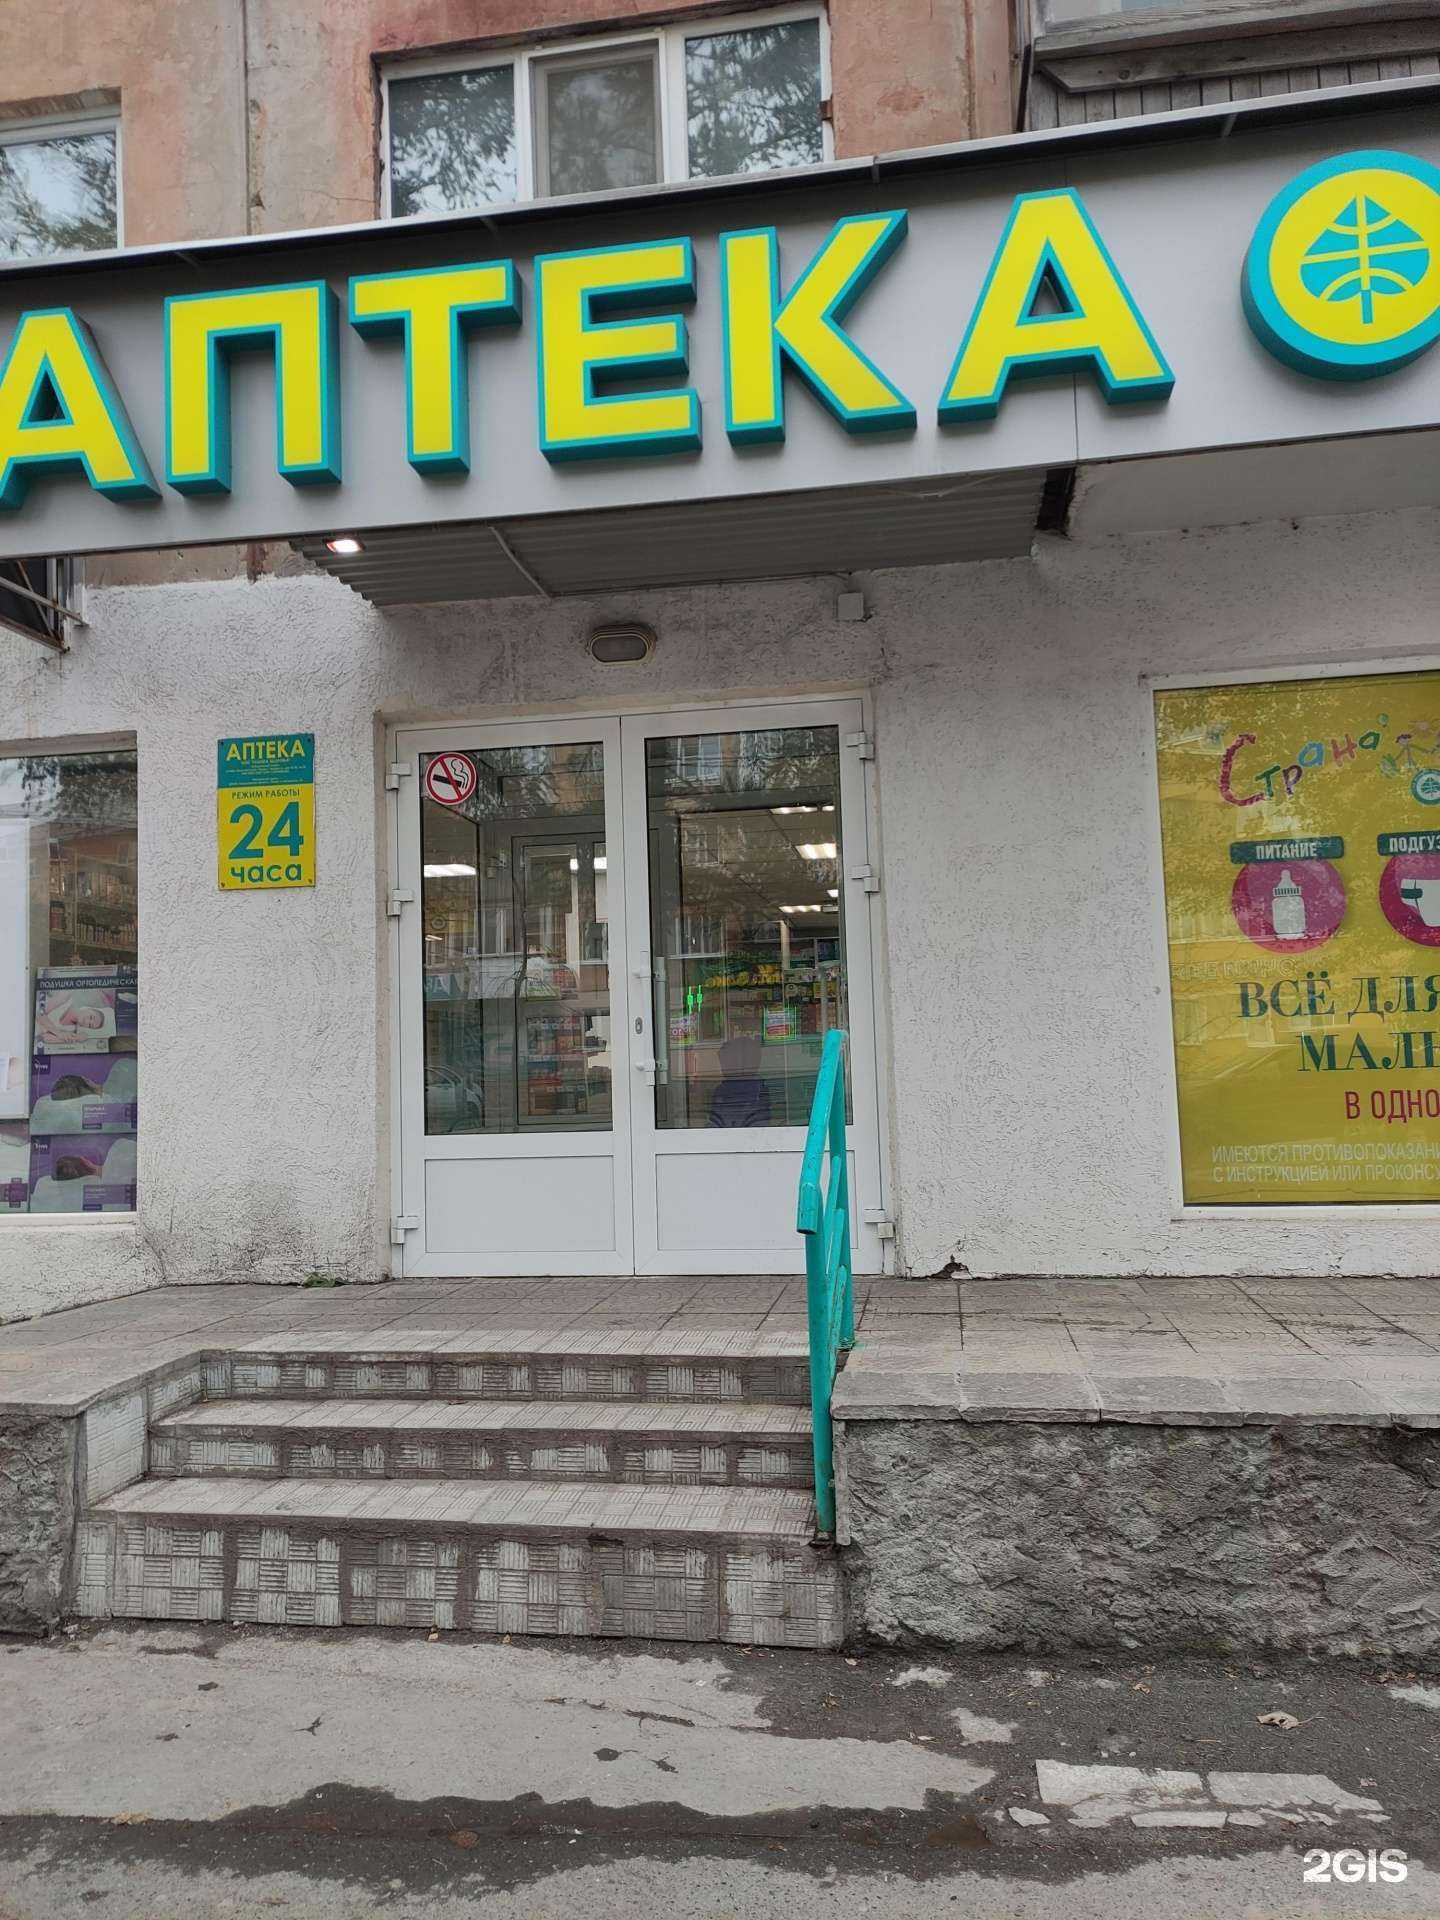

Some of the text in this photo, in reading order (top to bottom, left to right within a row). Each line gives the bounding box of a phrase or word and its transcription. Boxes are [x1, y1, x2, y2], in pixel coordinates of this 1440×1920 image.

[0, 186, 1175, 511] АПТЕКА
[226, 740, 306, 761] АПТЕКА
[1220, 730, 1381, 806] Страна
[231, 788, 300, 800] РЕЖИМ РАБОТЫ
[229, 801, 304, 859] 24
[1256, 842, 1318, 859] ПИТАНИЕ
[231, 864, 302, 883] часа
[40, 980, 74, 990] ПОДУШКА
[1235, 971, 1335, 1018] ВСЁ
[1345, 1089, 1440, 1123] В ОДНО
[1212, 1144, 1291, 1163] ИМЕЮТСЯ
[1213, 1166, 1225, 1183] С
[1227, 1163, 1329, 1184] ИНСТРУКЦИЕЙ
[1334, 1166, 1361, 1181] ИЛИ
